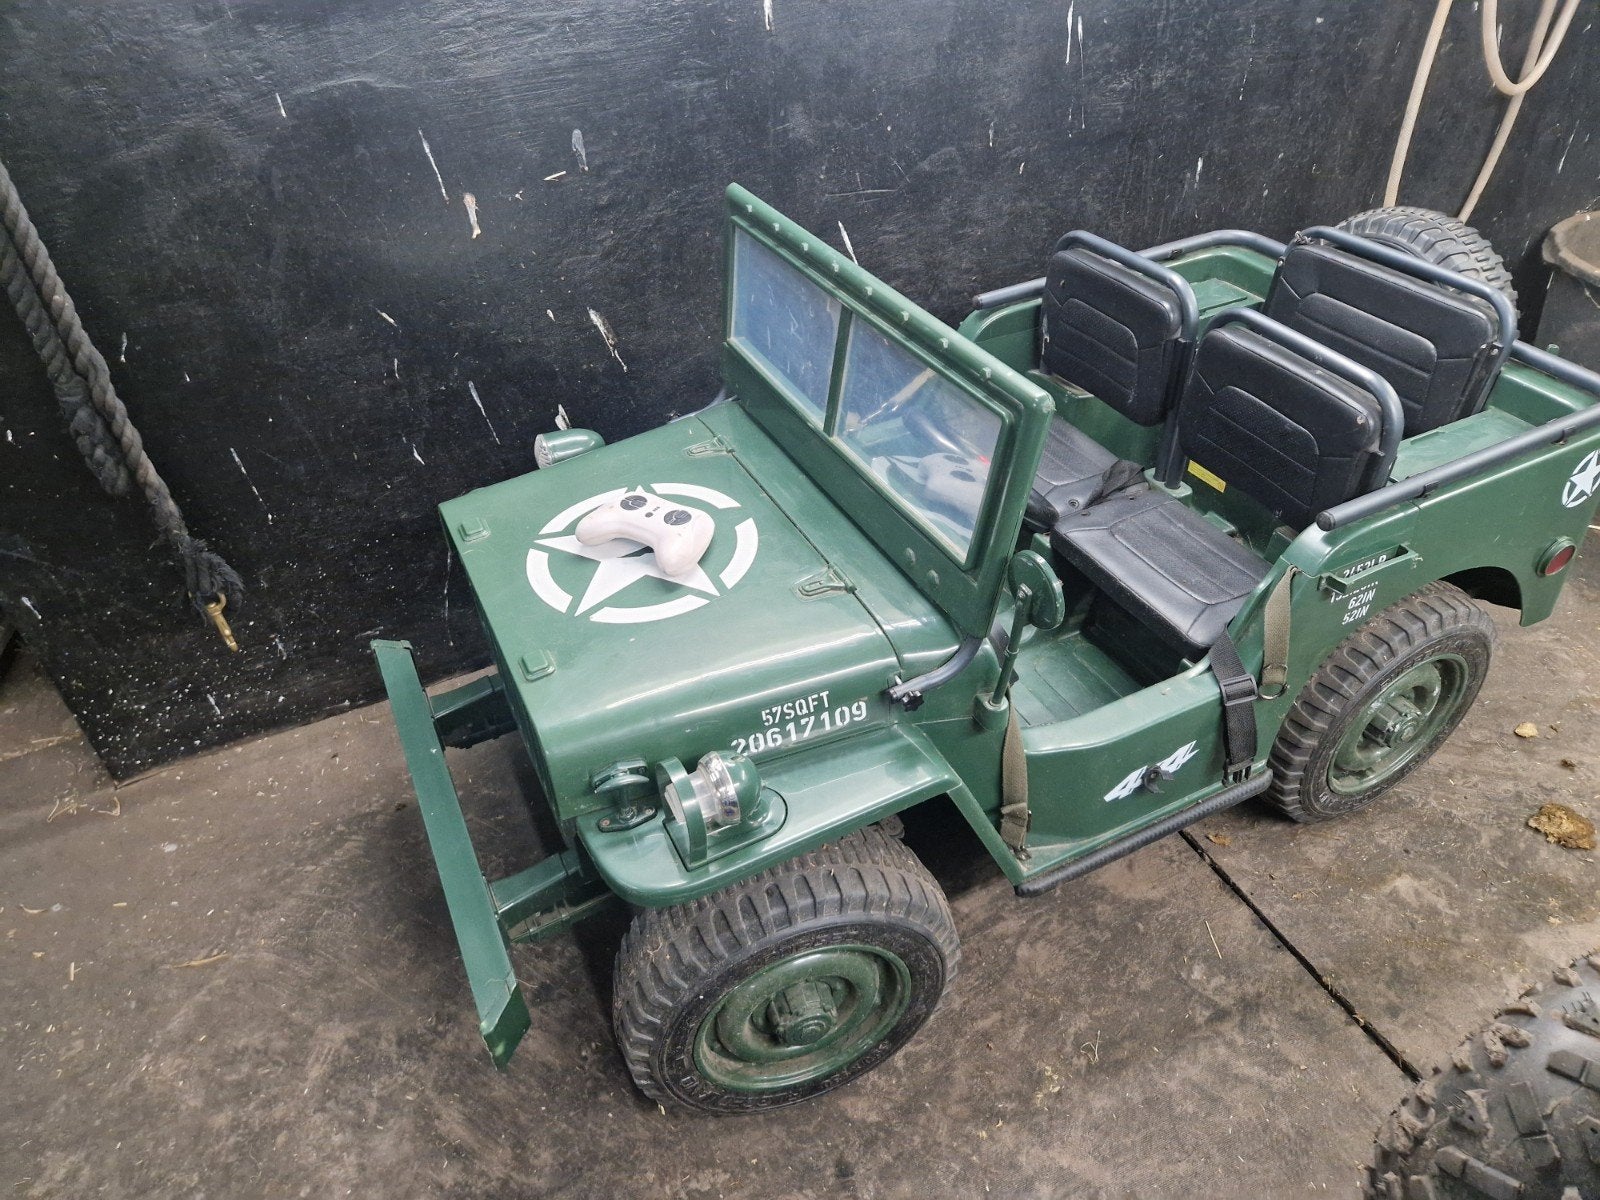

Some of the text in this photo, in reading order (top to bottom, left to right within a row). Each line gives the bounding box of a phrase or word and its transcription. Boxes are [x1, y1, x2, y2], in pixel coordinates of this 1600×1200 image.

[1348, 588, 1377, 610] 62IN
[1341, 604, 1371, 626] 52IN
[761, 690, 829, 726] 57SQFT
[730, 700, 867, 757] 20617109
